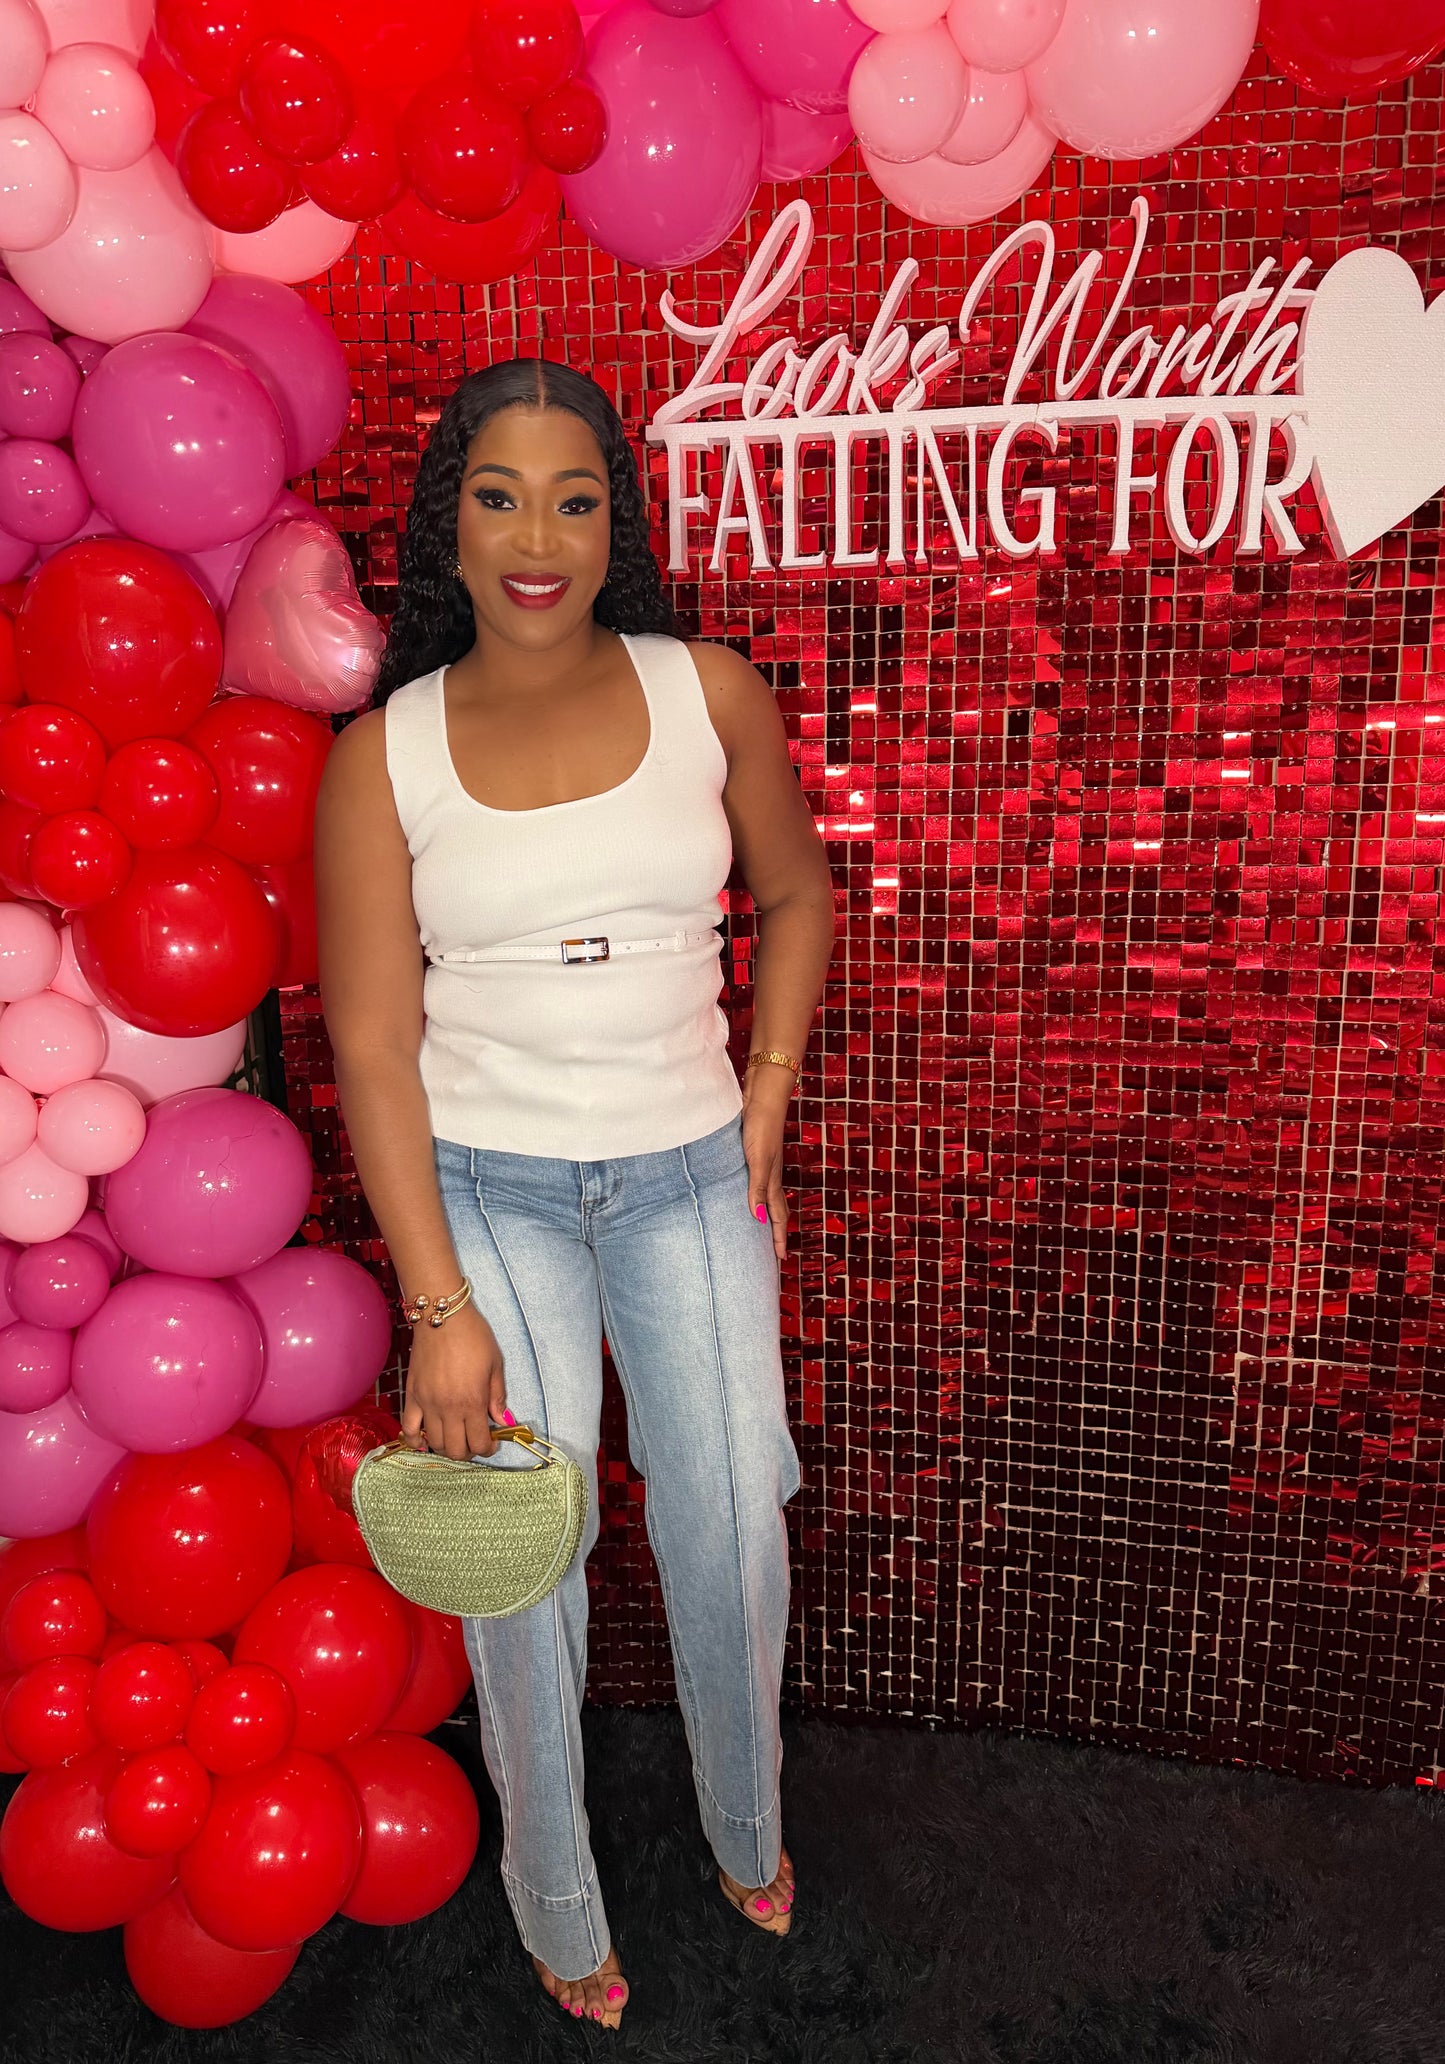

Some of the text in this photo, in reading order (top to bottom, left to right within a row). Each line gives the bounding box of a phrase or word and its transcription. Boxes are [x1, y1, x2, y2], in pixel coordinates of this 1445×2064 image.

[652, 195, 1317, 424] Looks Worth
[666, 410, 1314, 574] FALLING FOR
